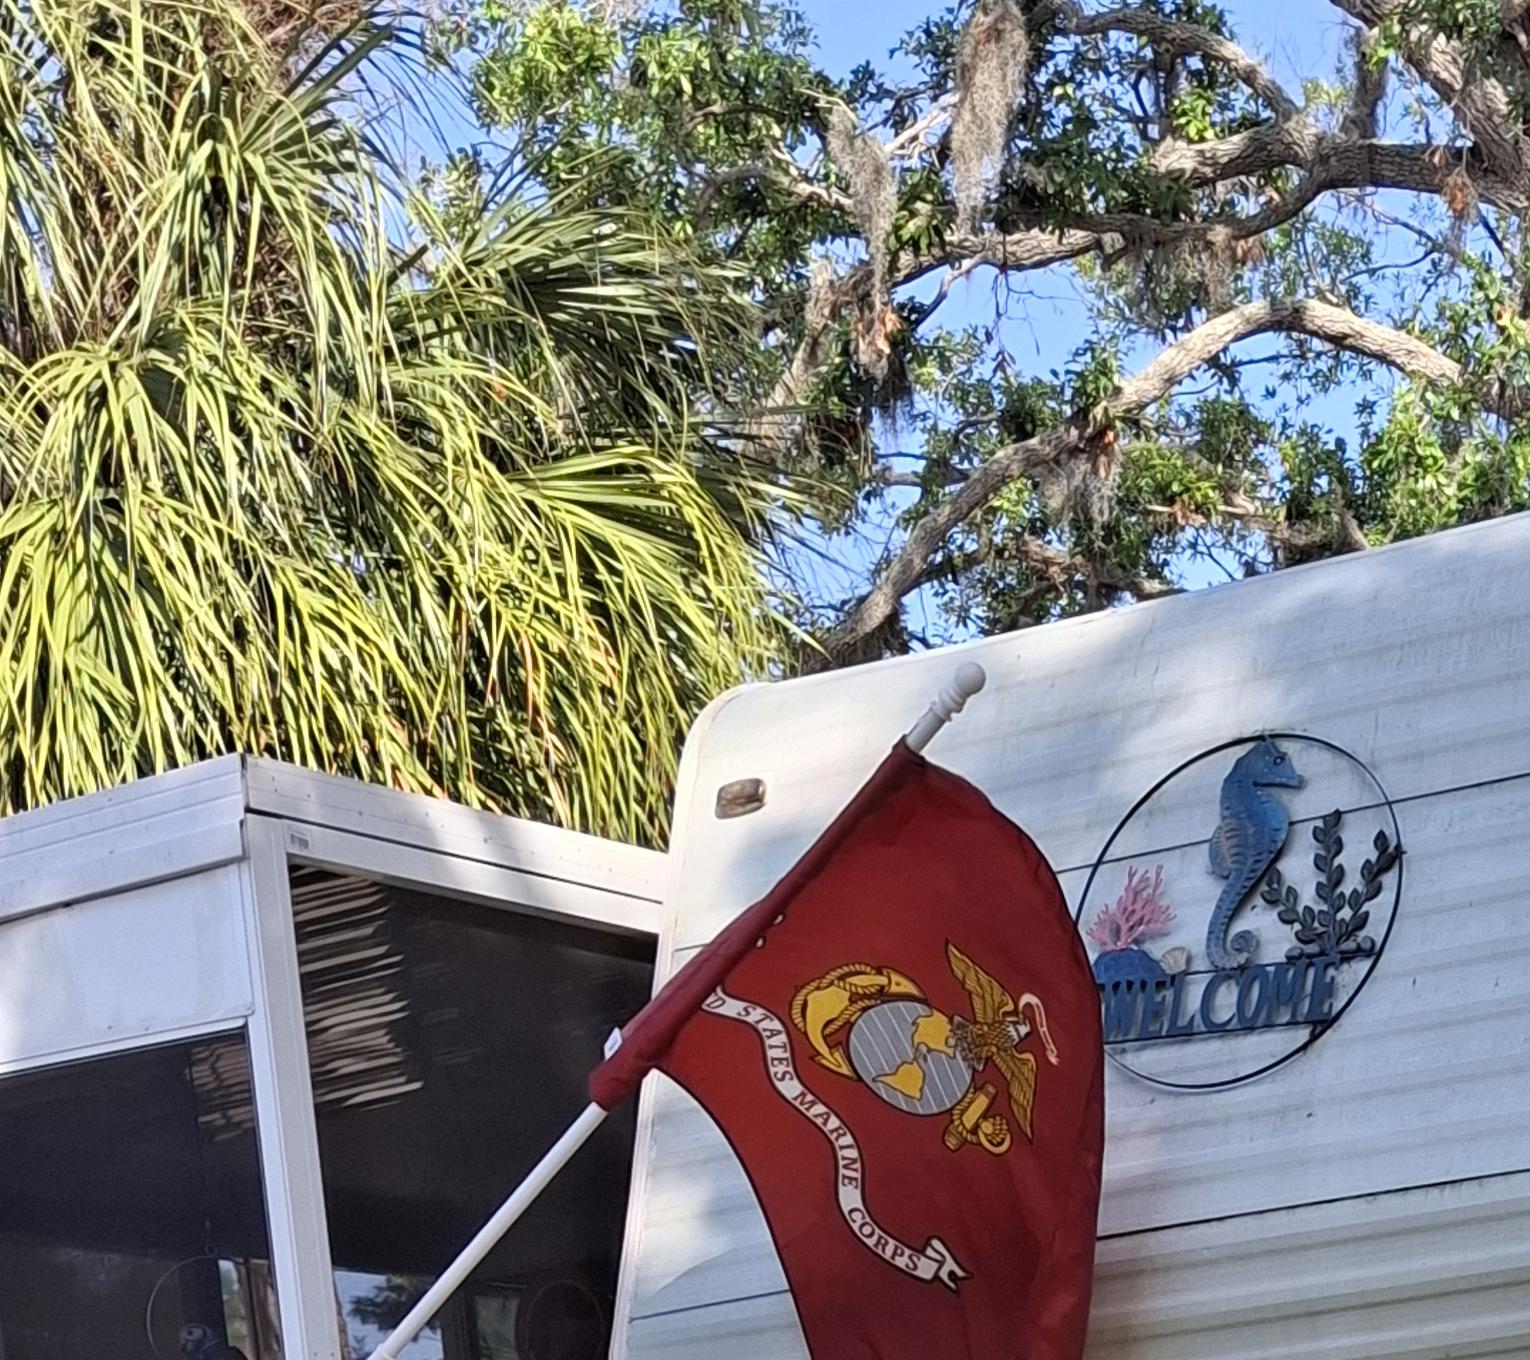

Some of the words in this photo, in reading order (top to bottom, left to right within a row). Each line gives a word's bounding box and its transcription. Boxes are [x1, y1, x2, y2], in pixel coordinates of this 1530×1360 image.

[1101, 954, 1337, 1041] WELCOME
[736, 1004, 795, 1083] STATES
[792, 1090, 861, 1189] MARINE
[847, 1205, 922, 1273] CORPS
